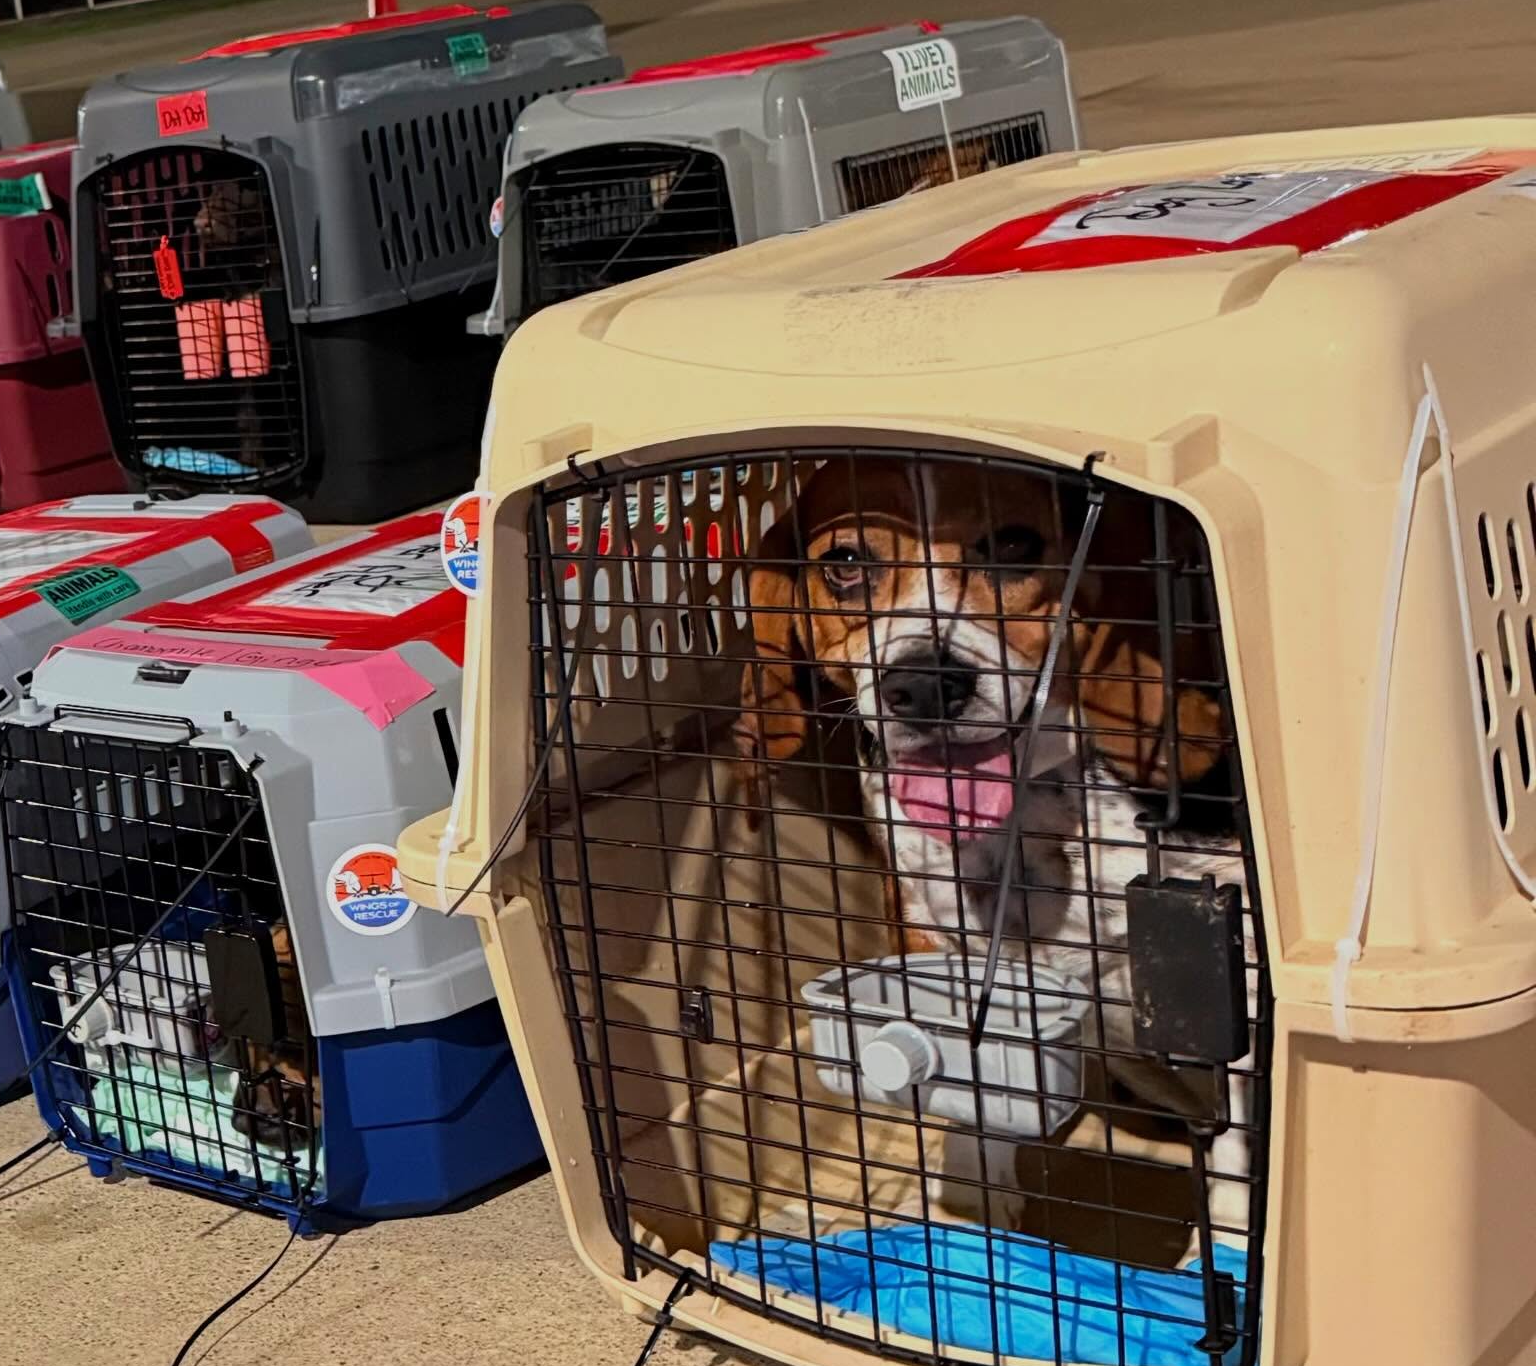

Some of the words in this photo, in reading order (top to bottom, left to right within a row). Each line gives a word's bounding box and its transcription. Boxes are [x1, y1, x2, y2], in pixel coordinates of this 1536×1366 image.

[906, 45, 940, 71] LIVE
[900, 66, 957, 102] ANIMALS
[46, 566, 119, 605] ANIMALS
[112, 582, 130, 595] care
[349, 901, 388, 912] WINGS
[353, 909, 398, 921] RESCUE
